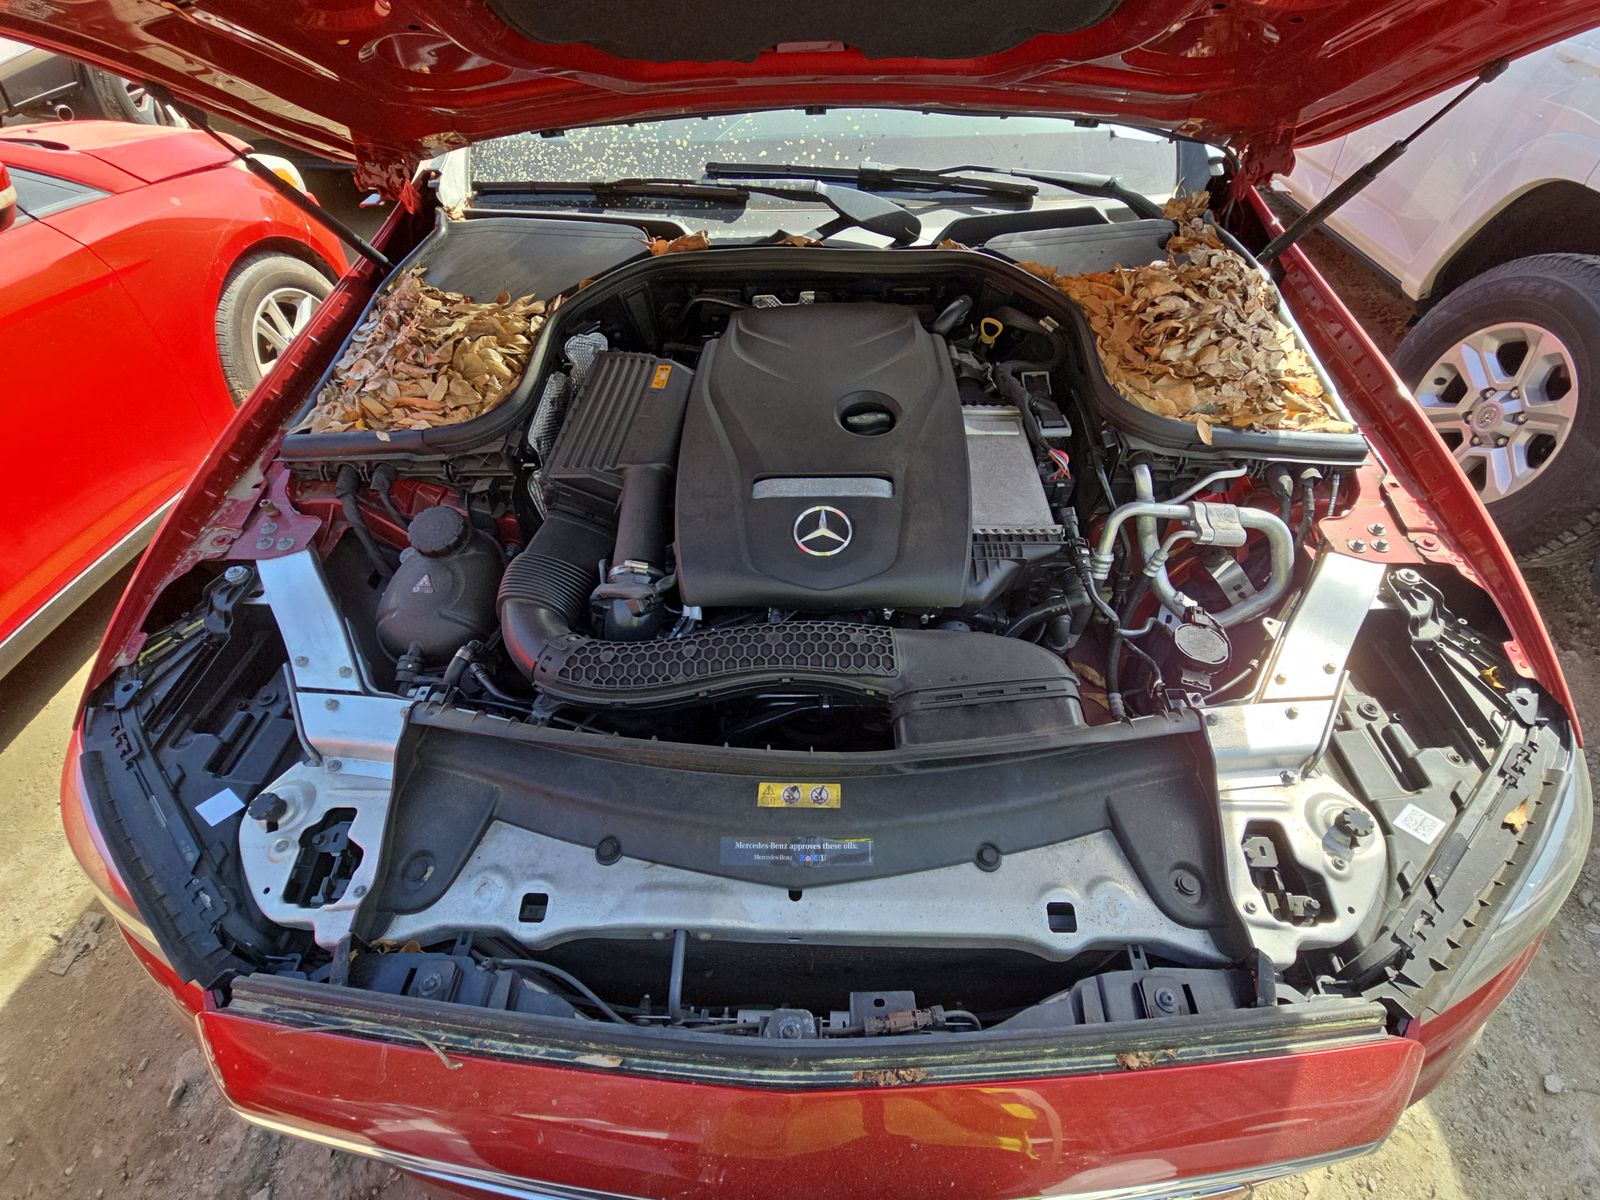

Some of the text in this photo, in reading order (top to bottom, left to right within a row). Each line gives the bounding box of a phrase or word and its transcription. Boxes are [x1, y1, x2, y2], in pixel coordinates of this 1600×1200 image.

[735, 841, 788, 850] Mercedes-Benz
[789, 843, 822, 852] approves
[823, 841, 842, 850] these
